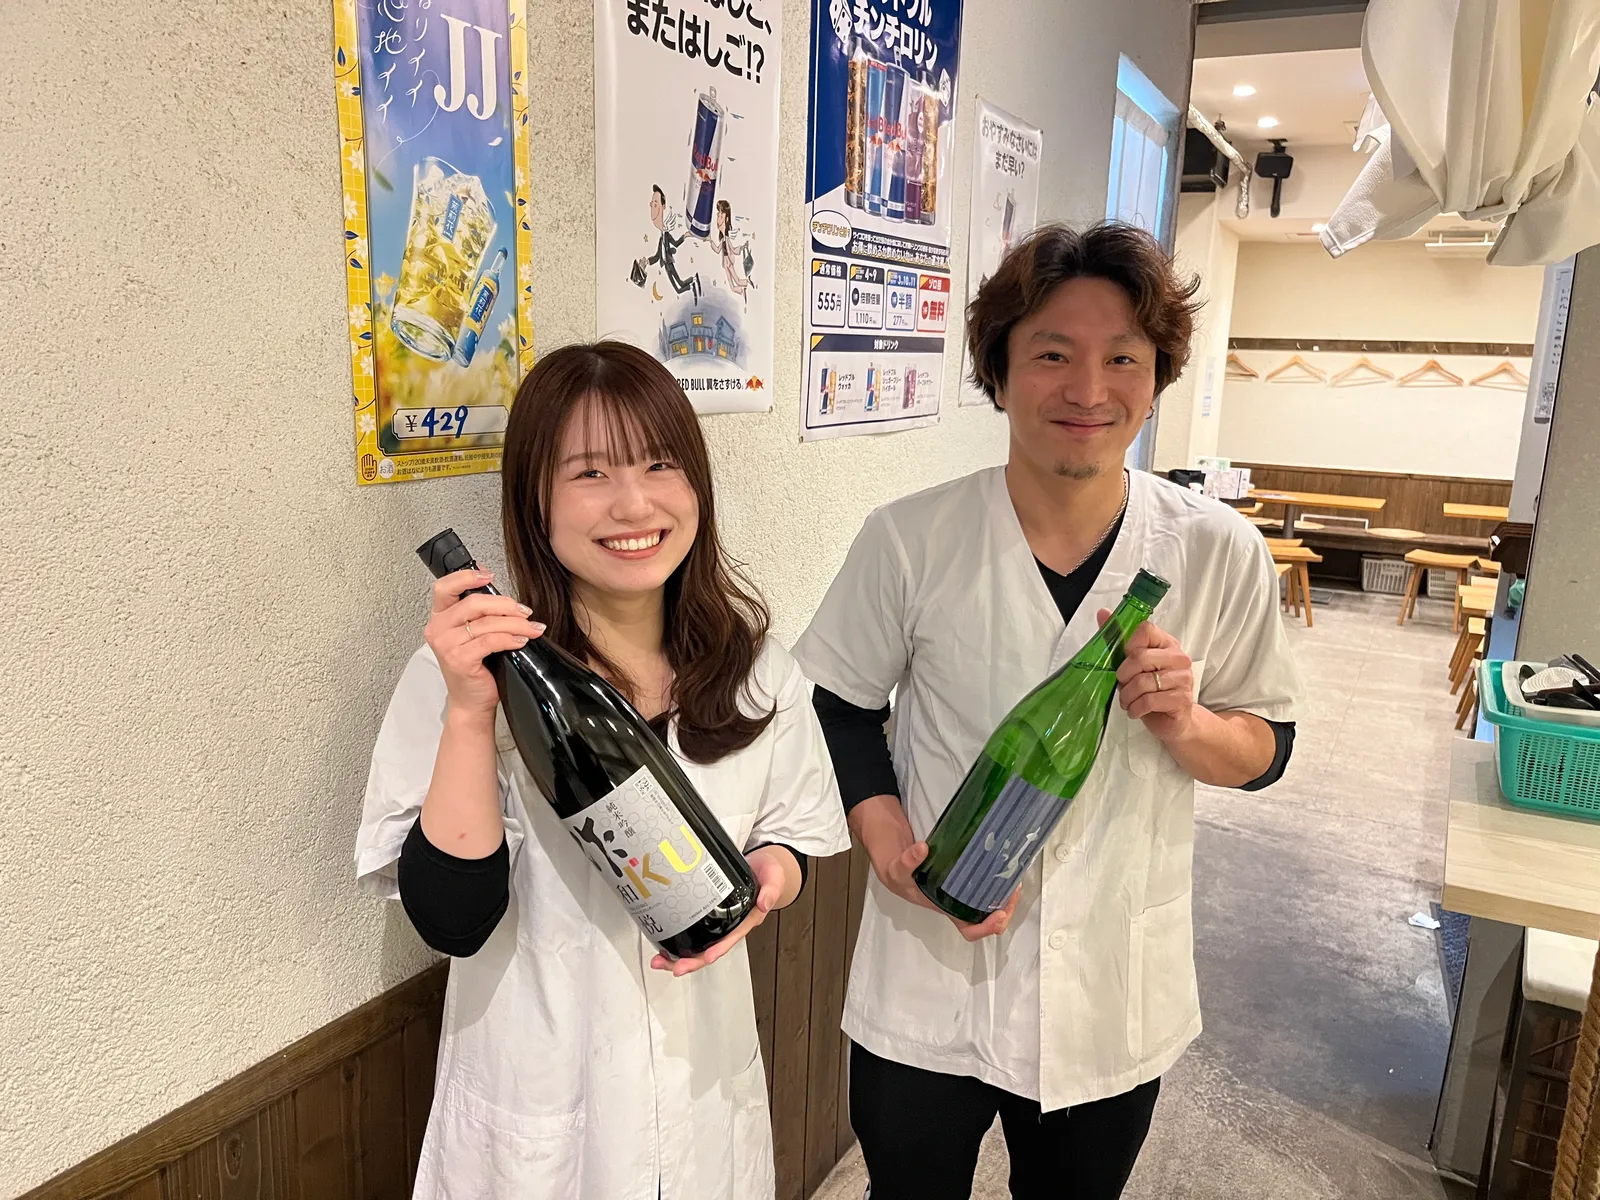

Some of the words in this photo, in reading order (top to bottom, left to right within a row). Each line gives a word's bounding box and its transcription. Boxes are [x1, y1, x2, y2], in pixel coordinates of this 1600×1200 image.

[434, 13, 503, 120] JJ
[929, 300, 945, 322] 無料
[690, 378, 706, 391] BULL
